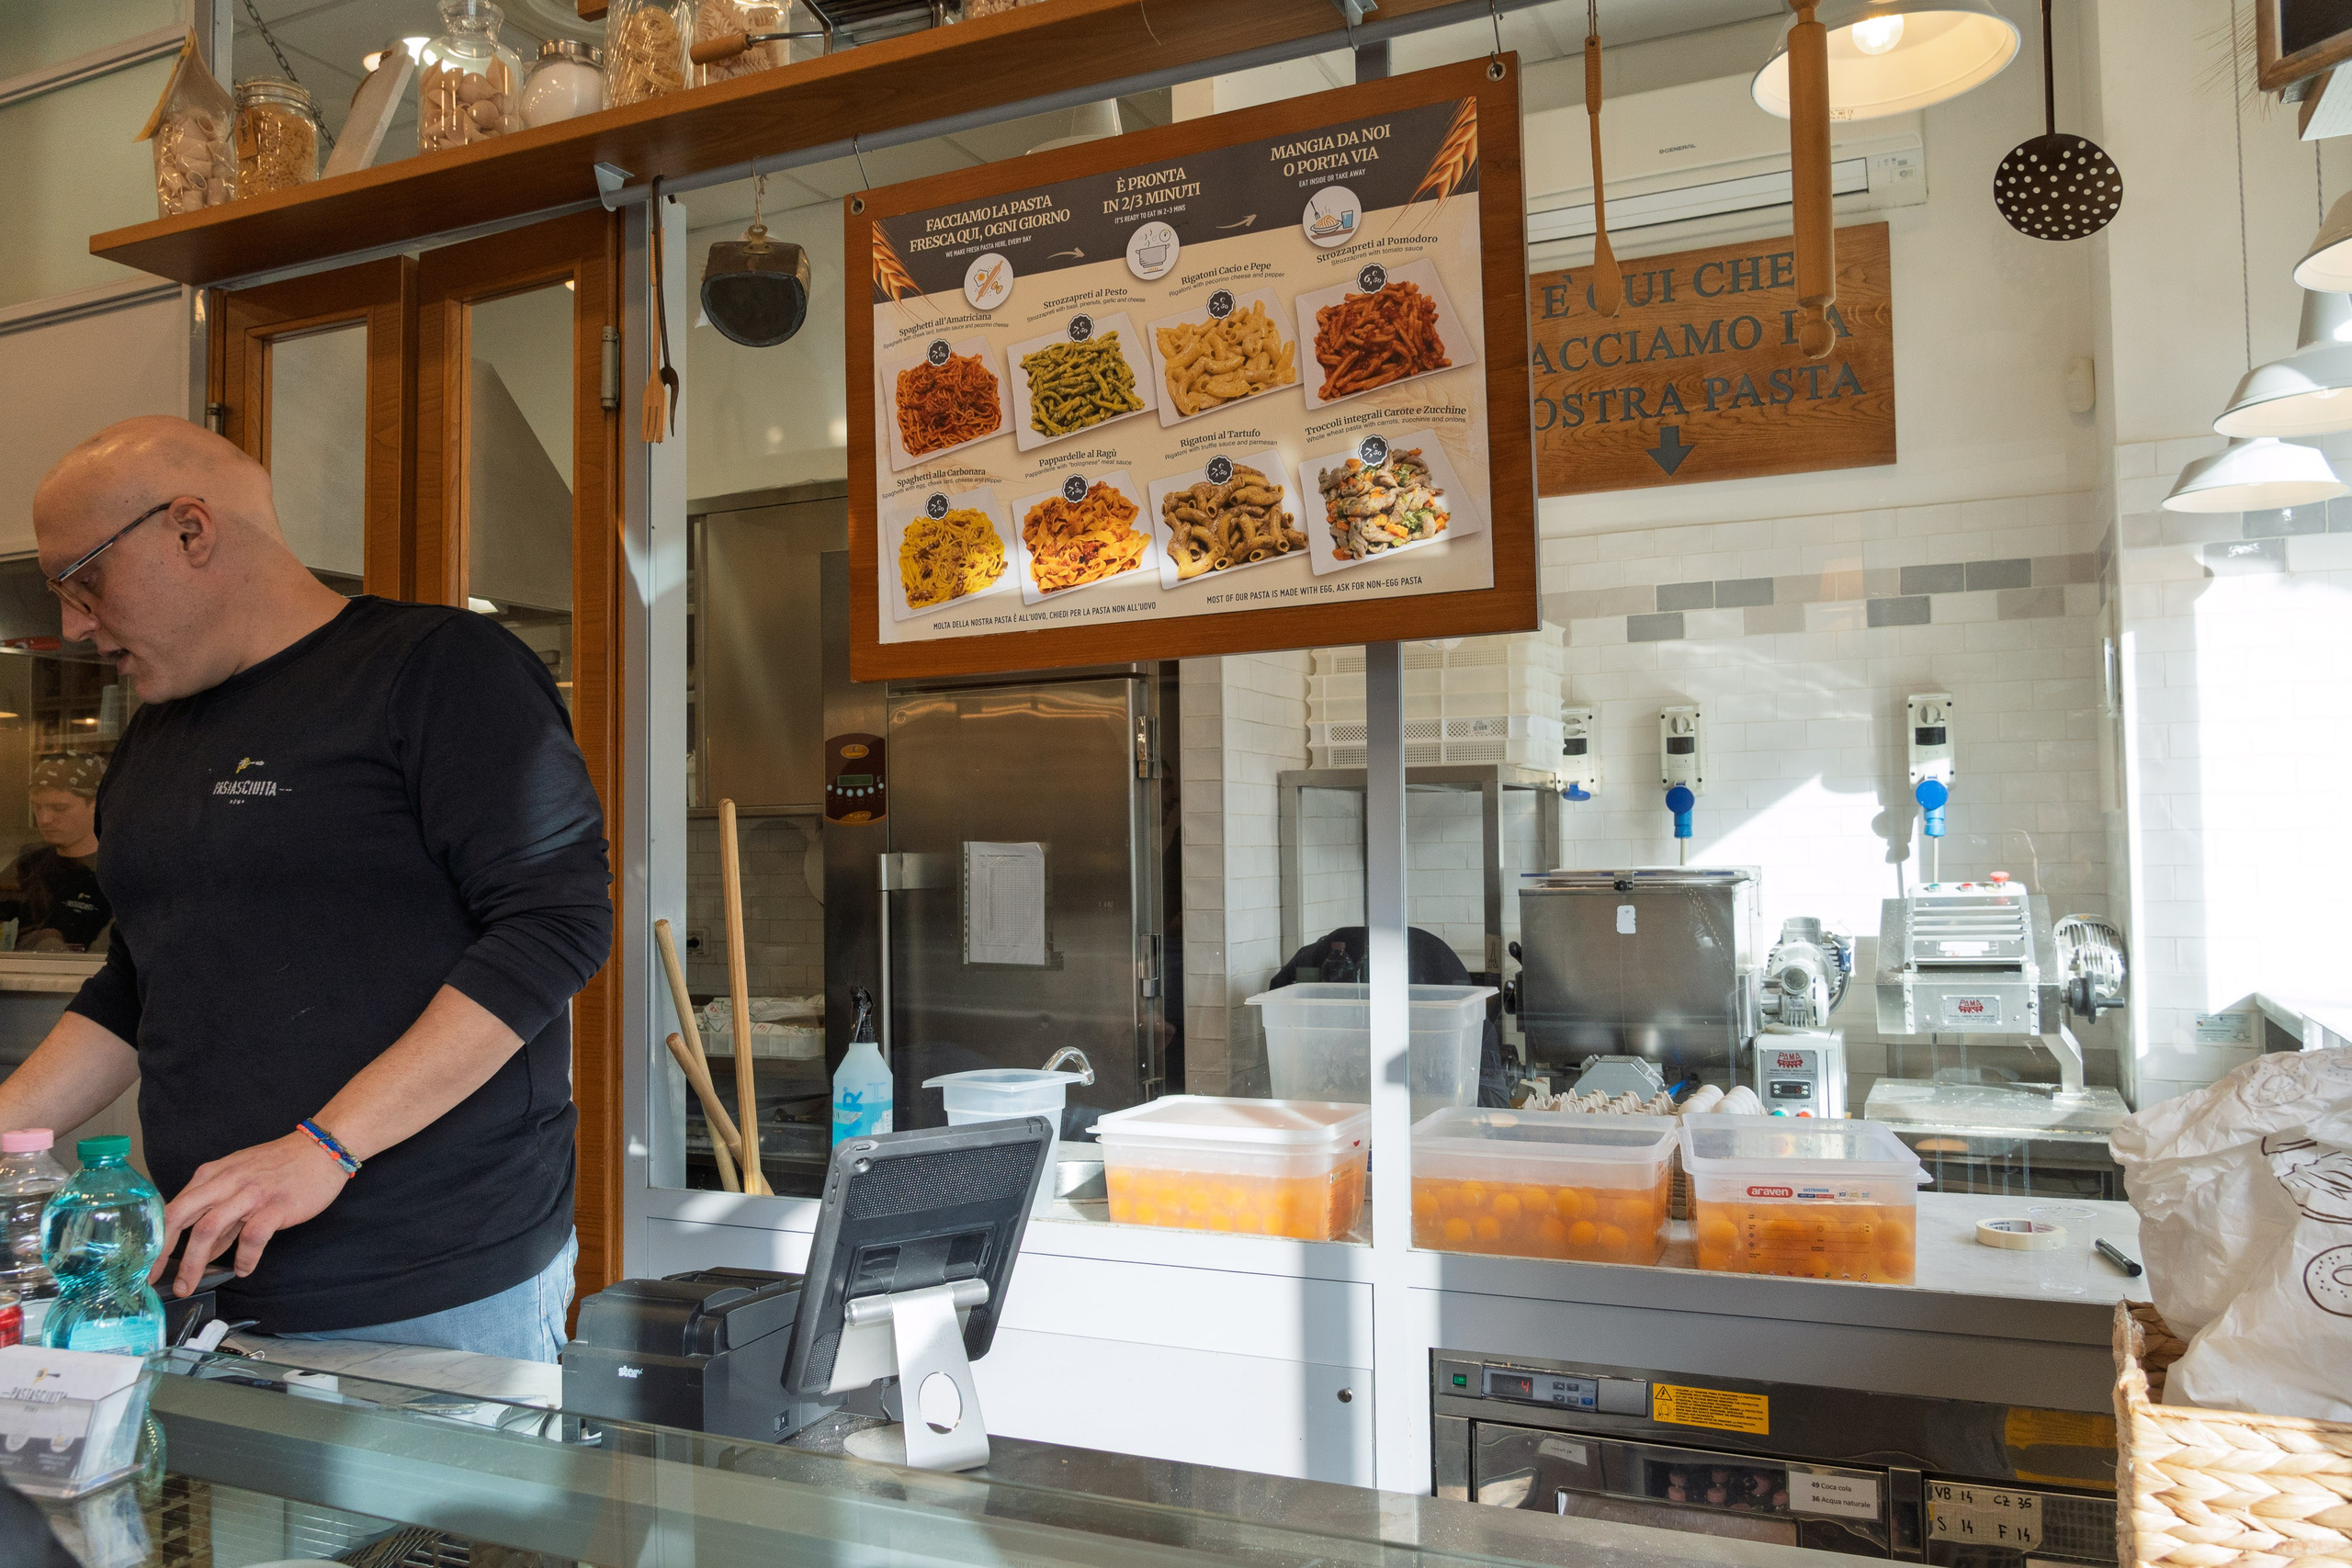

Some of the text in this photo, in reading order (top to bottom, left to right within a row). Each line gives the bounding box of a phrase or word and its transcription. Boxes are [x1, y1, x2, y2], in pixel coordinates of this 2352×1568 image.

[1271, 123, 1391, 162] MANGIA DA NOI
[1283, 146, 1379, 177] O PORTA VIA
[1116, 167, 1186, 194] È PRONTA
[1298, 168, 1366, 187] EAT INSIDE OR TAKE AWAY
[1102, 182, 1201, 215] IN 2/3 MINUTI
[925, 195, 1053, 232] FACCIAMO LA PASTA
[1114, 204, 1186, 224] IT'S READY TO EAT IN 2-3 MINS
[910, 209, 1070, 253] FRESCA QUI, OGNI GIORNO
[954, 248, 966, 257] MAKE
[967, 246, 980, 254] FRESH
[980, 243, 994, 252] PASTA
[995, 240, 1008, 249] HERE,
[1008, 237, 1022, 246] EVERY
[1022, 235, 1033, 243] DAY
[1317, 234, 1439, 264] Strozzapreti al Pomodoro
[1331, 252, 1367, 266] Strozzapreti
[1368, 249, 1381, 257] with
[1382, 246, 1403, 254] tomato
[1169, 286, 1193, 298] Rigatoni
[1193, 280, 1204, 289] with
[1205, 276, 1230, 288] pecorino
[1230, 273, 1251, 281] cheese
[1264, 271, 1285, 279] pepper
[1181, 267, 1217, 286] Rigatoni
[1218, 264, 1242, 276] Cacio
[1250, 262, 1272, 274] Pepe
[1692, 251, 1795, 299] CHE
[1043, 288, 1128, 310] Strozzapreti al Pesto
[899, 312, 991, 337] Spaghetti all'Amatriciana
[1532, 314, 1762, 377] ACCIAMO
[1534, 361, 1867, 432] OSTRA PASTA
[1305, 405, 1467, 436] Troccoli integrali Carote e Zucchine
[1306, 433, 1326, 444] Whole
[1326, 427, 1345, 437] wheat
[1345, 424, 1363, 434] pasta
[1363, 421, 1376, 429] with
[1377, 418, 1399, 427] carrots,
[1401, 415, 1430, 423] zucchinis
[1430, 415, 1444, 423] and
[1164, 448, 1188, 460] Rigatoni
[1188, 445, 1201, 453] with
[1201, 442, 1217, 450] truffle
[1249, 439, 1278, 447] parmesan
[1180, 428, 1261, 448] Rigatoni al Tartufo
[1038, 448, 1117, 468] Pappardelle al Ragù
[897, 468, 986, 489] Spaghetti alla Carbonara
[1206, 575, 1423, 604] MOST OF OUR PASTA IS MADE WITH EGG, ASK FOR NON-EGG PASTA
[933, 601, 1157, 631] MOLTA DELLA NOSTRA PASTA È ALL'UOVO, CHIEDI PER LA PASTA NON ALL'UOVO
[1778, 1052, 1801, 1061] PAMA
[1751, 1188, 1789, 1197] araven
[1521, 1380, 1530, 1393] 4
[1821, 1483, 1837, 1491] Coca
[1838, 1484, 1852, 1493] cola
[1821, 1496, 1842, 1505] Acqua
[1843, 1500, 1871, 1508] naturale
